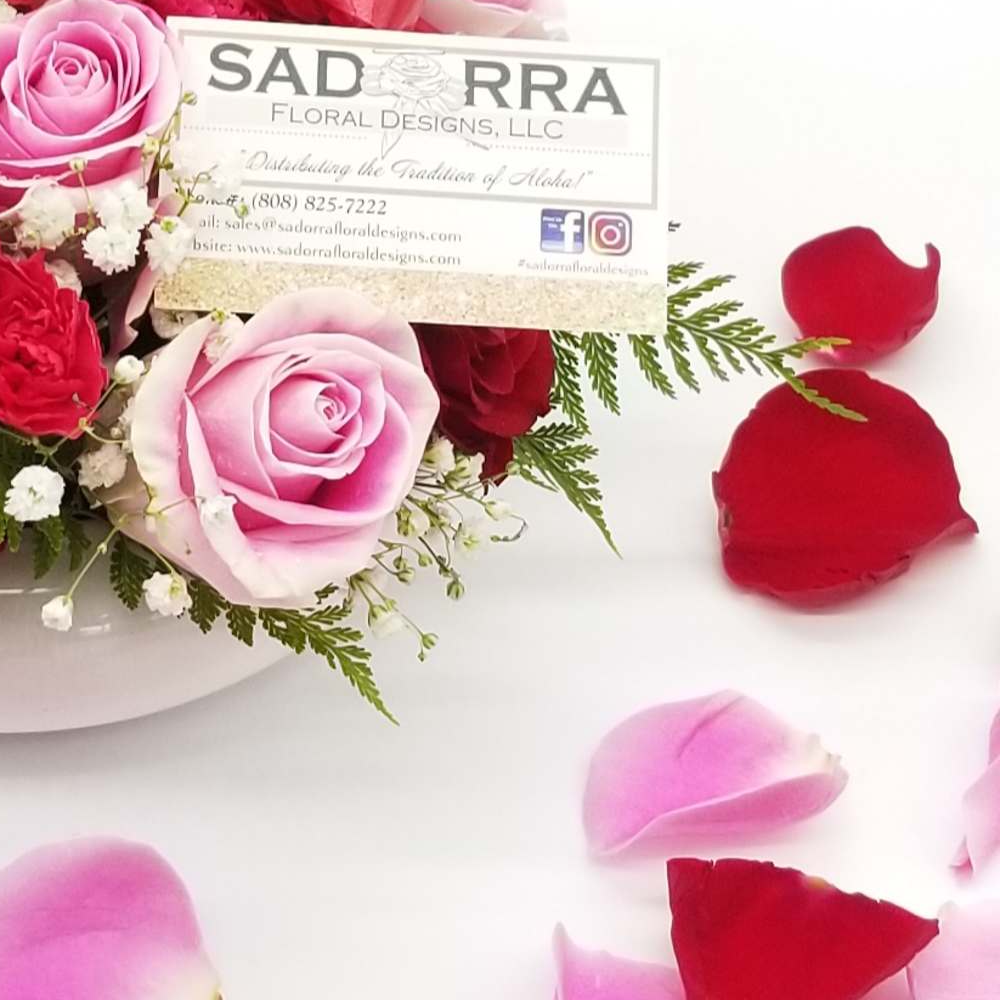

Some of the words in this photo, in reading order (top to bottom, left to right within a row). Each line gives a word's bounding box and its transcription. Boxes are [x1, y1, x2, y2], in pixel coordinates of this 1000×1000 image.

[509, 117, 564, 140] LLC
[357, 157, 384, 178] the
[390, 159, 475, 182] Tradition
[482, 164, 508, 192] of
[251, 192, 298, 212] (808)
[304, 195, 388, 215] 825-7222
[199, 215, 220, 229] ail:
[224, 217, 462, 243] sales@sadorrafloraldesigns.com
[192, 234, 232, 252] bsite:
[236, 241, 461, 266] www.sadorrafloraldesigns.com
